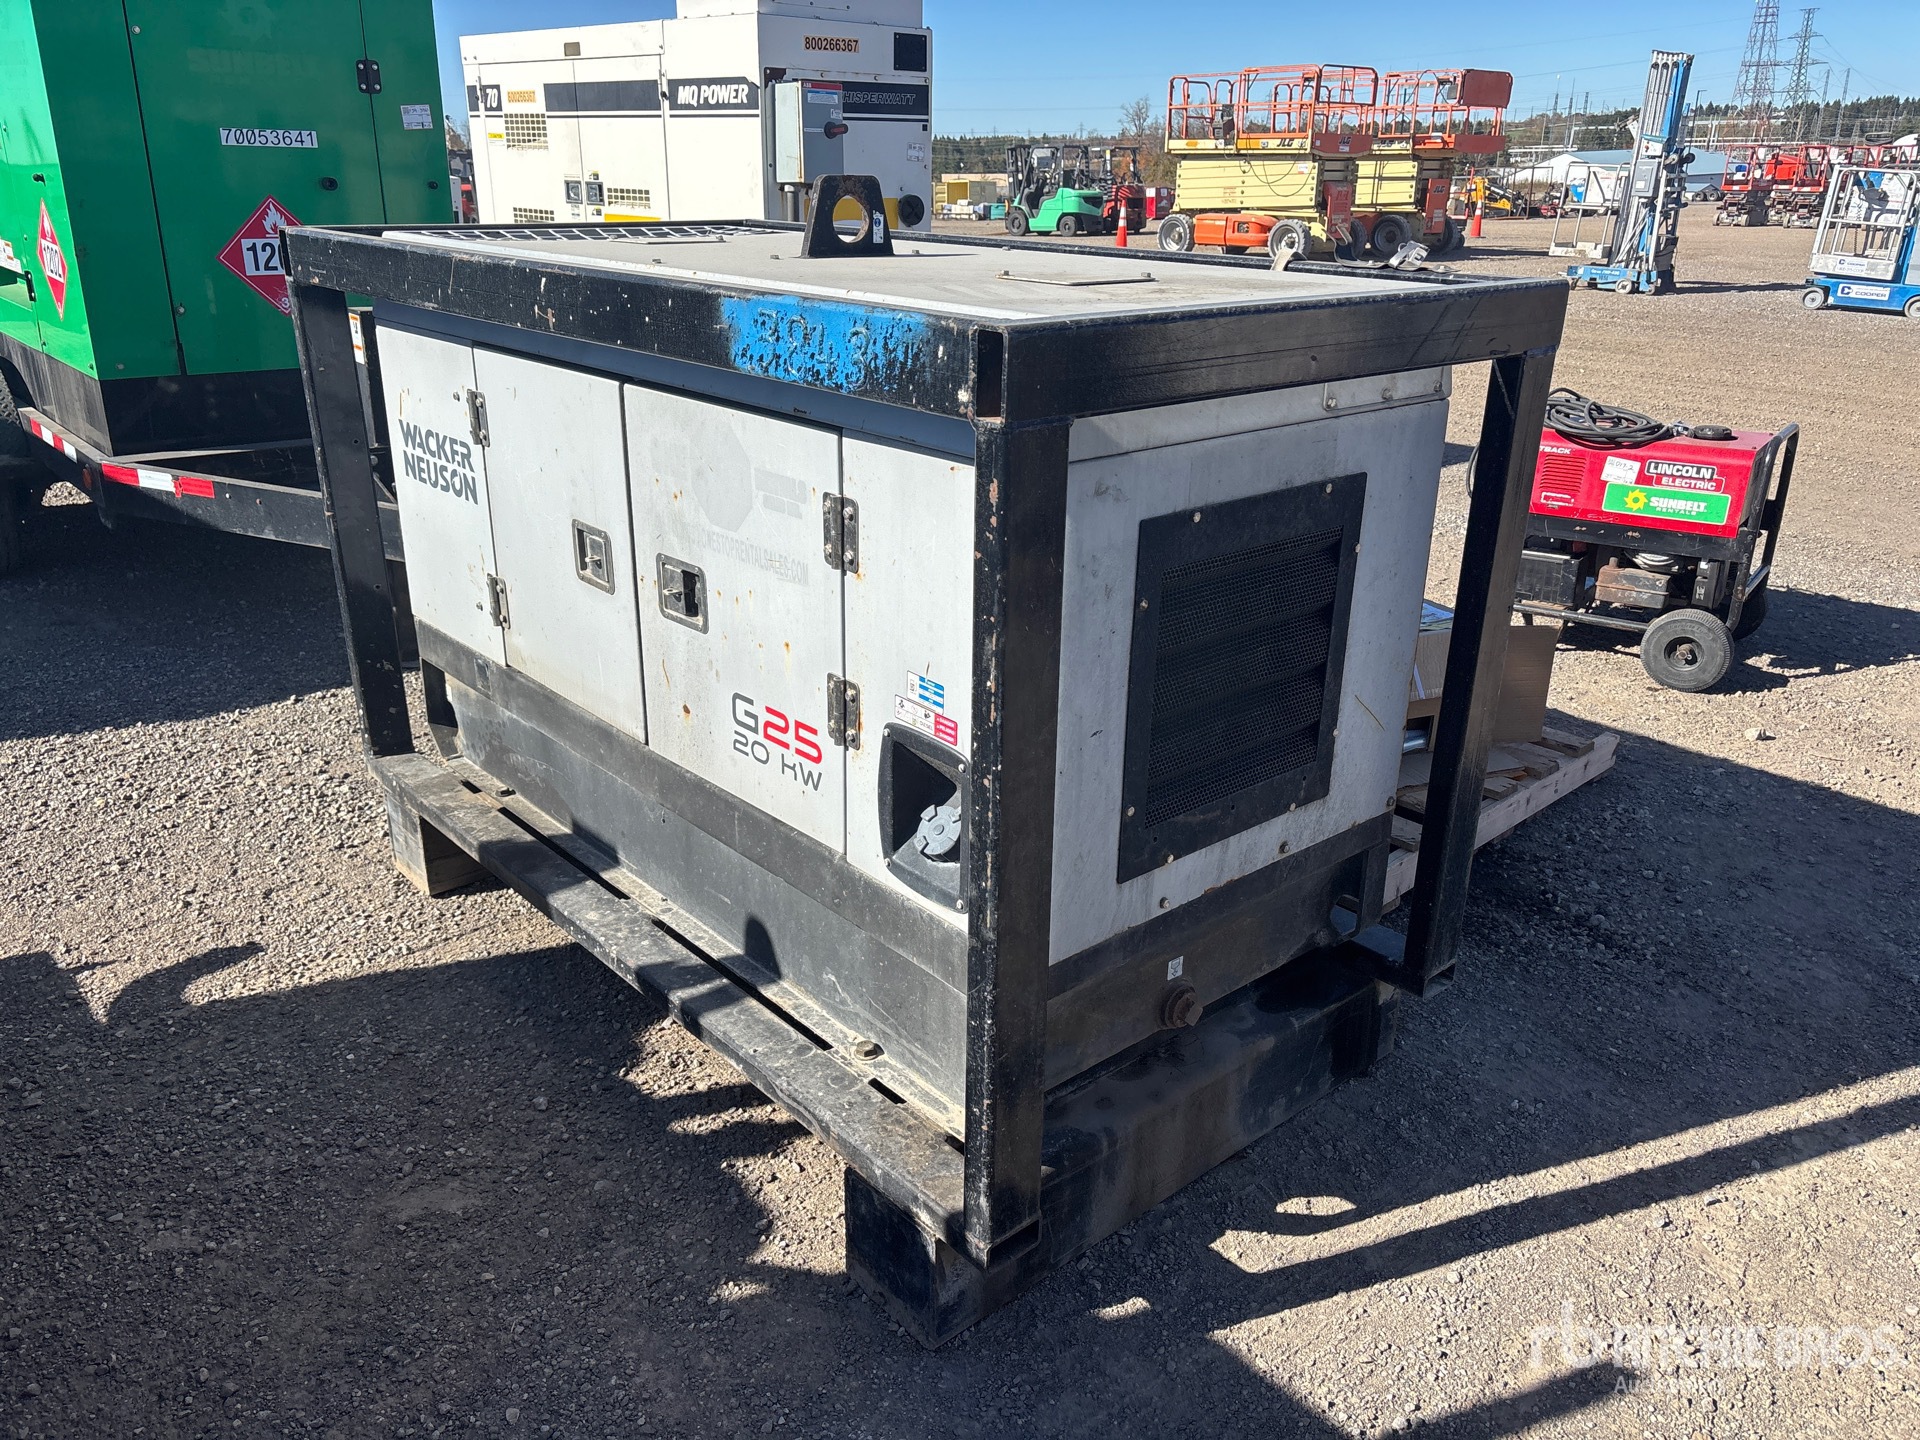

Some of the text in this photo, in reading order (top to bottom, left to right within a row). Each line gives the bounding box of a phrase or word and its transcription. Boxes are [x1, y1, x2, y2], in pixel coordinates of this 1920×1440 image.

[804, 36, 859, 52] 800266367
[485, 88, 498, 108] 70
[677, 84, 749, 107] MQ POWER
[842, 91, 915, 105] HISPERWATT
[222, 128, 315, 146] 70053641
[1276, 138, 1294, 147] JLG
[1338, 136, 1352, 145] JLG
[1855, 291, 1887, 303] COOPER
[398, 418, 476, 474] WACKER
[402, 449, 479, 506] NEUSON
[1648, 462, 1713, 480] LINCOLN
[1661, 476, 1717, 491] ELECTRIC
[1649, 496, 1707, 512] SUNBELT
[1655, 506, 1697, 516] RENTALS
[731, 692, 823, 765] G25
[732, 729, 770, 766] 20
